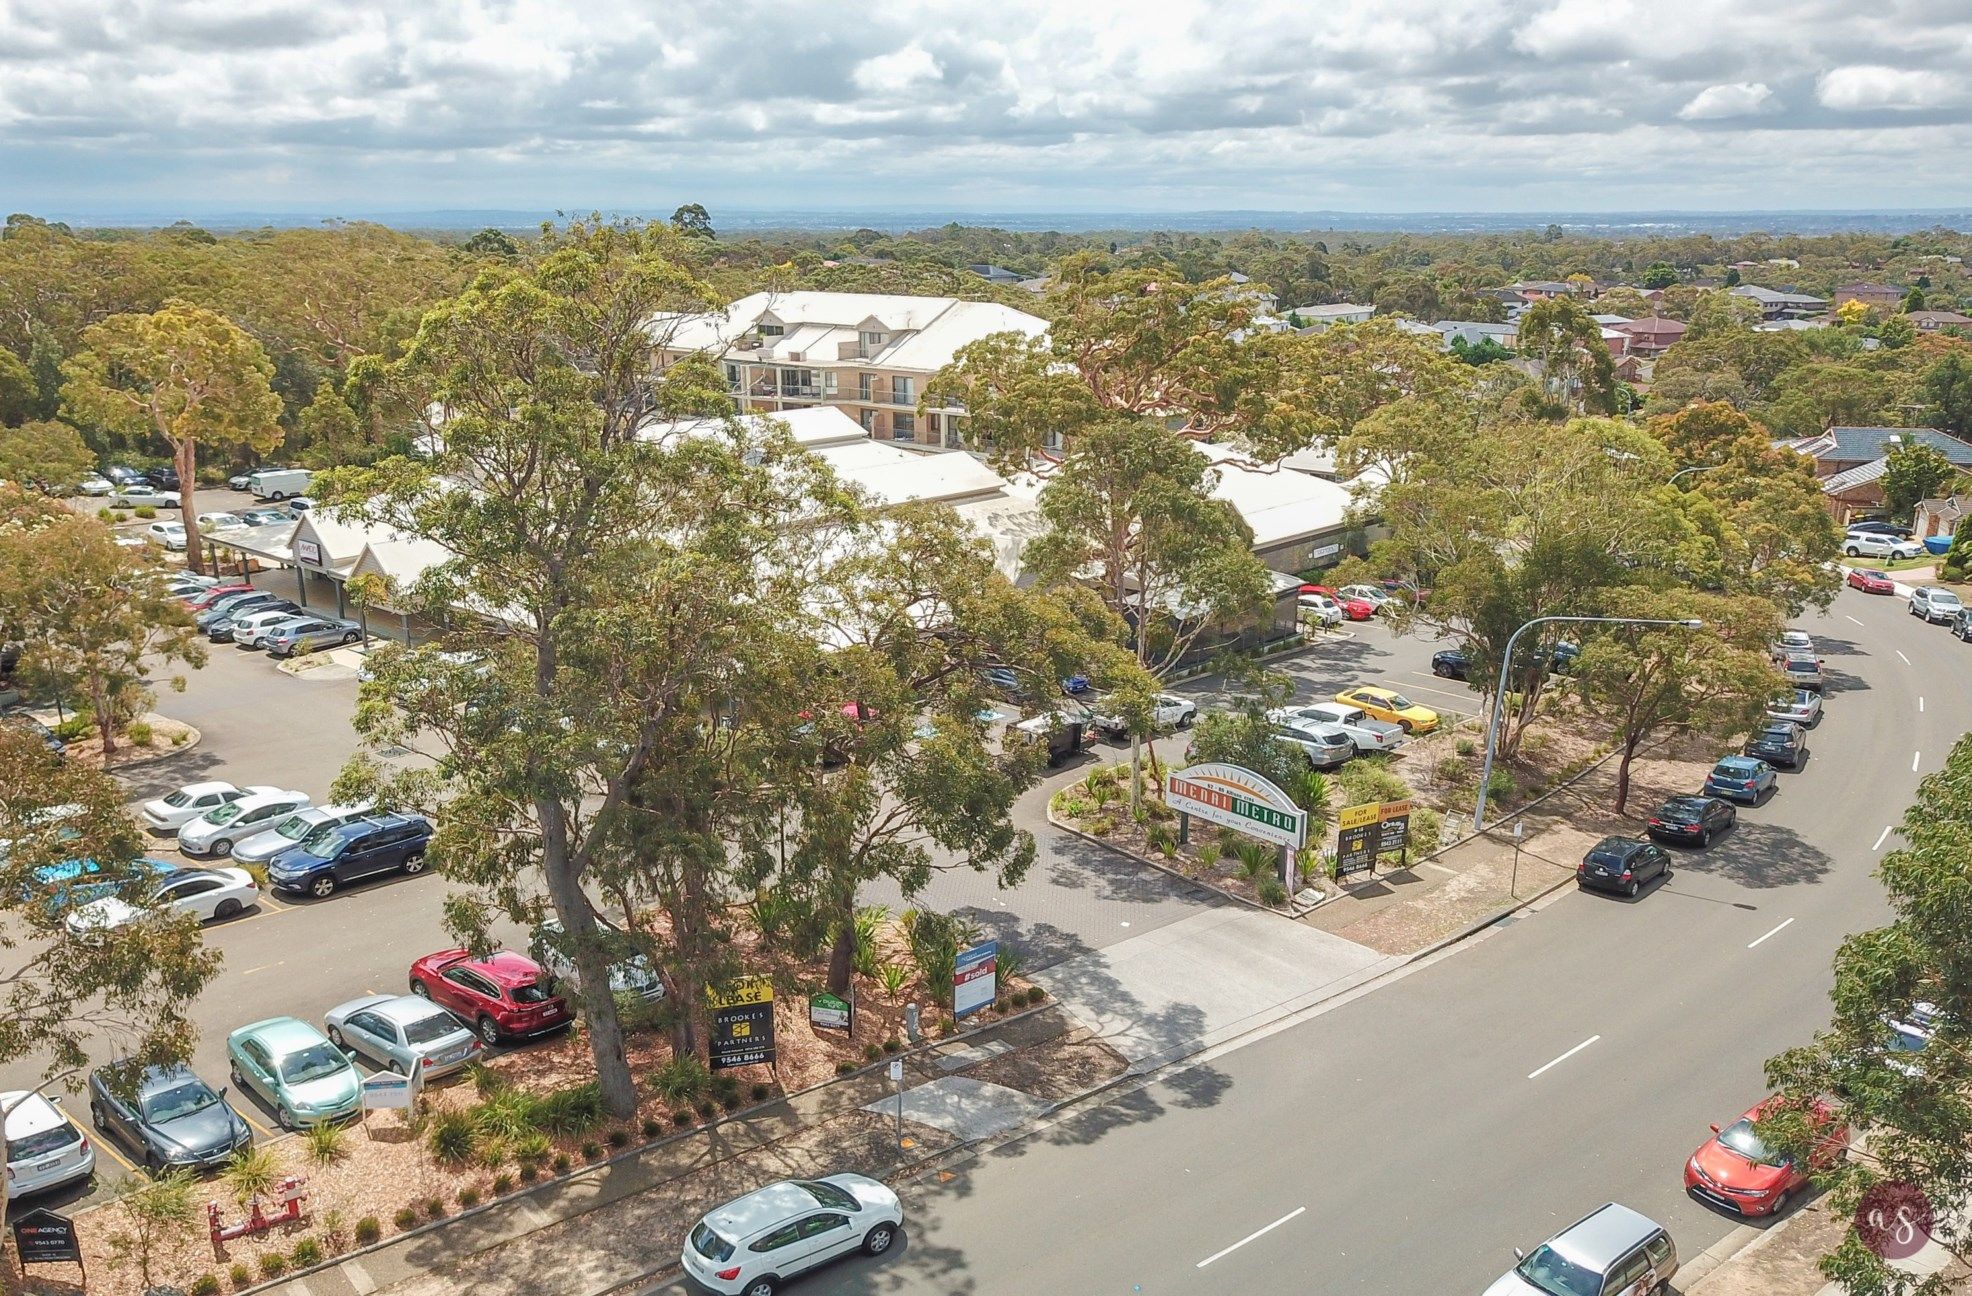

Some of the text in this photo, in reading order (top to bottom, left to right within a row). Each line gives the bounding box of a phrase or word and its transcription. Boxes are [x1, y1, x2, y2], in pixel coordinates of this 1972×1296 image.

[1236, 799, 1292, 830] METRO
[1354, 809, 1367, 817] FOR
[1380, 804, 1408, 815] FOR LEASE
[1342, 813, 1377, 826] SALE/LEASE
[1212, 810, 1223, 819] for
[1245, 821, 1291, 842] Convenience
[964, 966, 988, 982] #sold
[717, 1012, 764, 1024] BROOKES
[717, 1035, 766, 1047] PARTNERS
[721, 1056, 742, 1064] 9546
[743, 1053, 765, 1061] 8666
